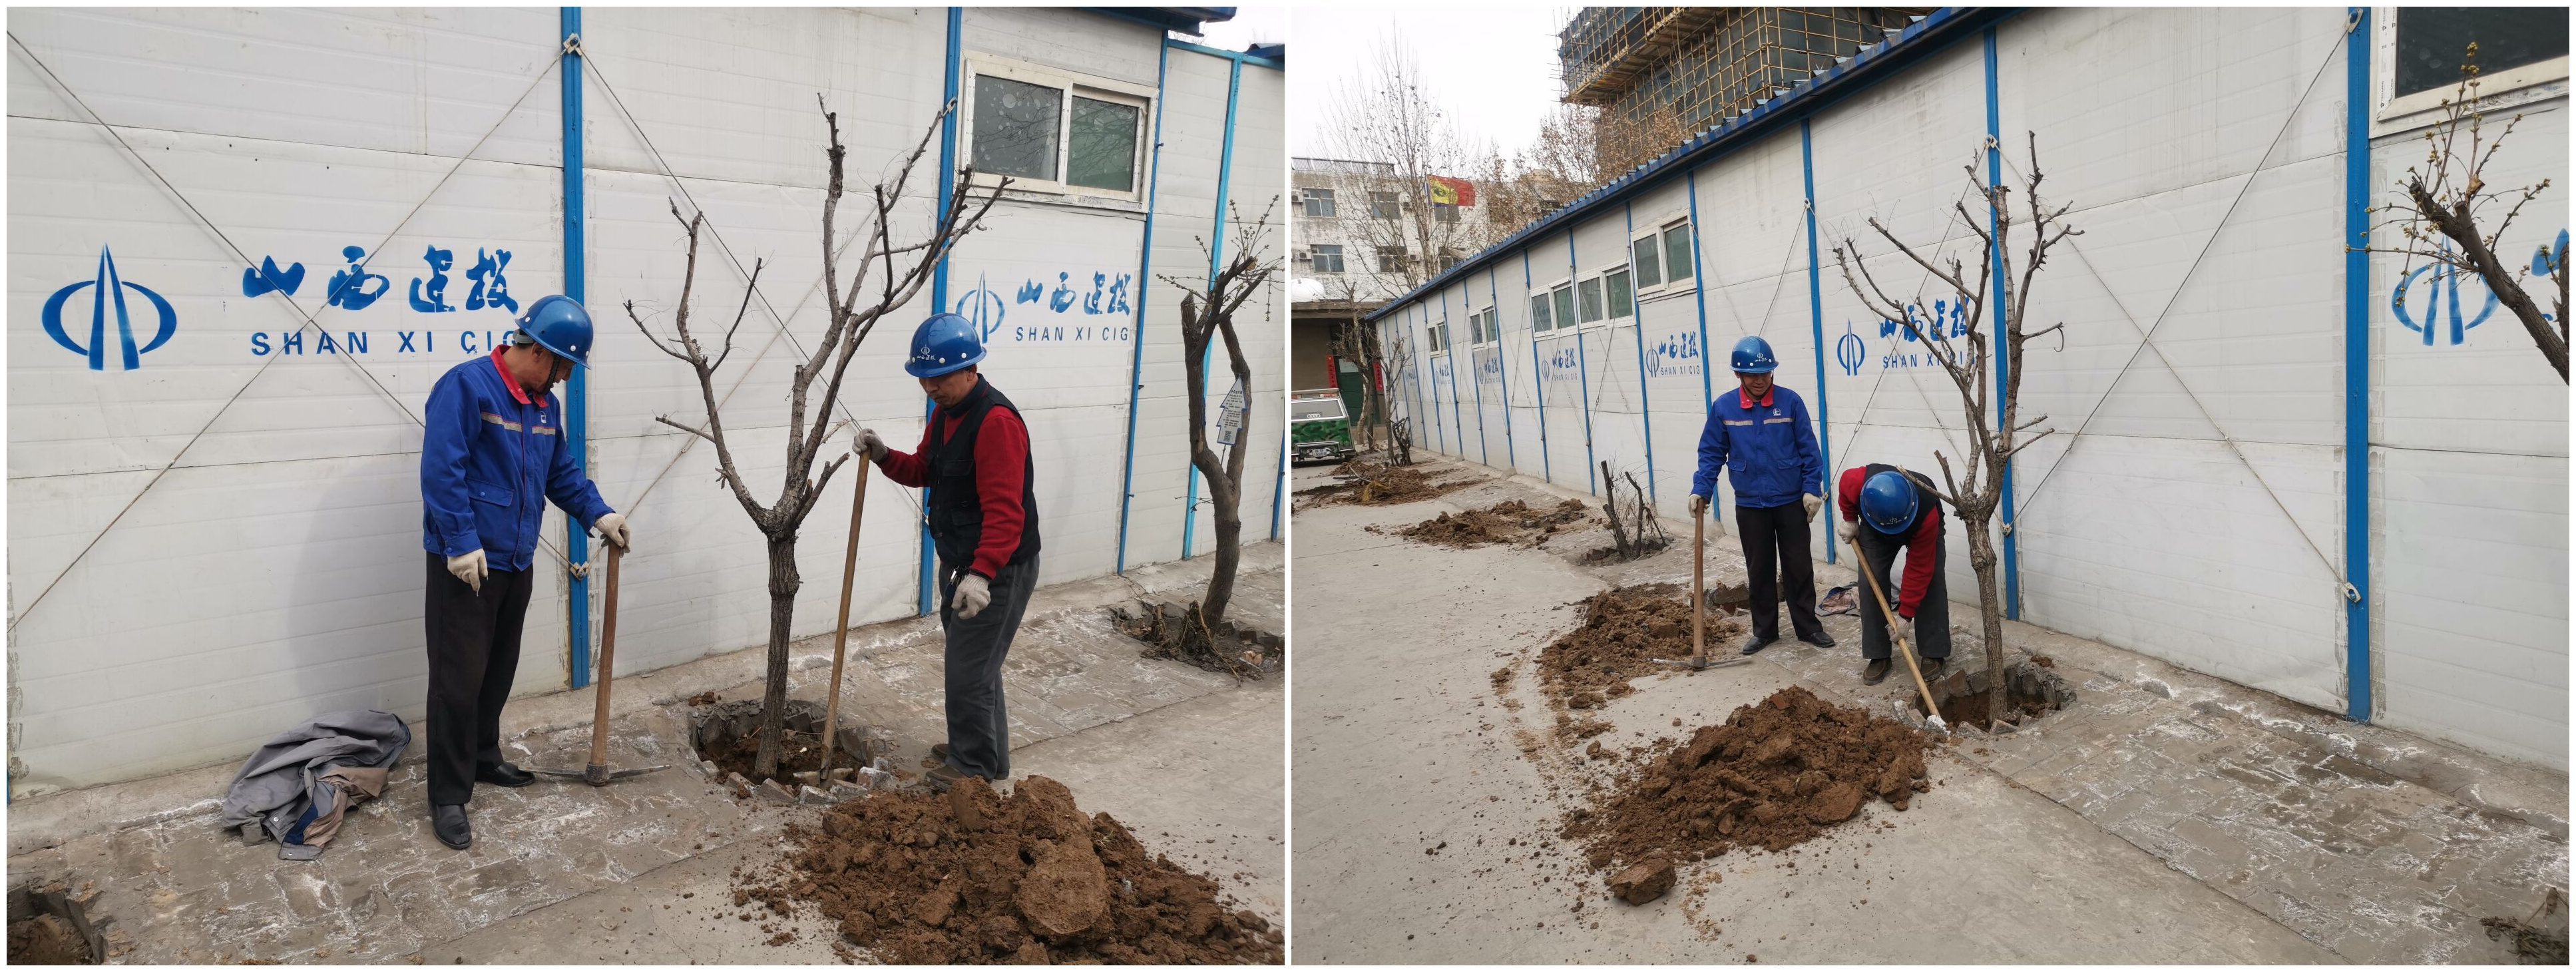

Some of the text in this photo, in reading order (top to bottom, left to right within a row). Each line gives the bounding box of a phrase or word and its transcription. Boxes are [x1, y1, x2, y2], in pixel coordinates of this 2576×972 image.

[242, 244, 519, 315] 山西建投
[1016, 270, 1131, 316] 山西建投
[251, 332, 368, 356] SHAN
[397, 331, 433, 353] XI
[1016, 326, 1128, 342] SHAN XI CIG
[1659, 330, 1699, 359] 山西建投
[1660, 365, 1700, 375] SHAN XI CIG
[1883, 354, 1918, 368] SHAN
